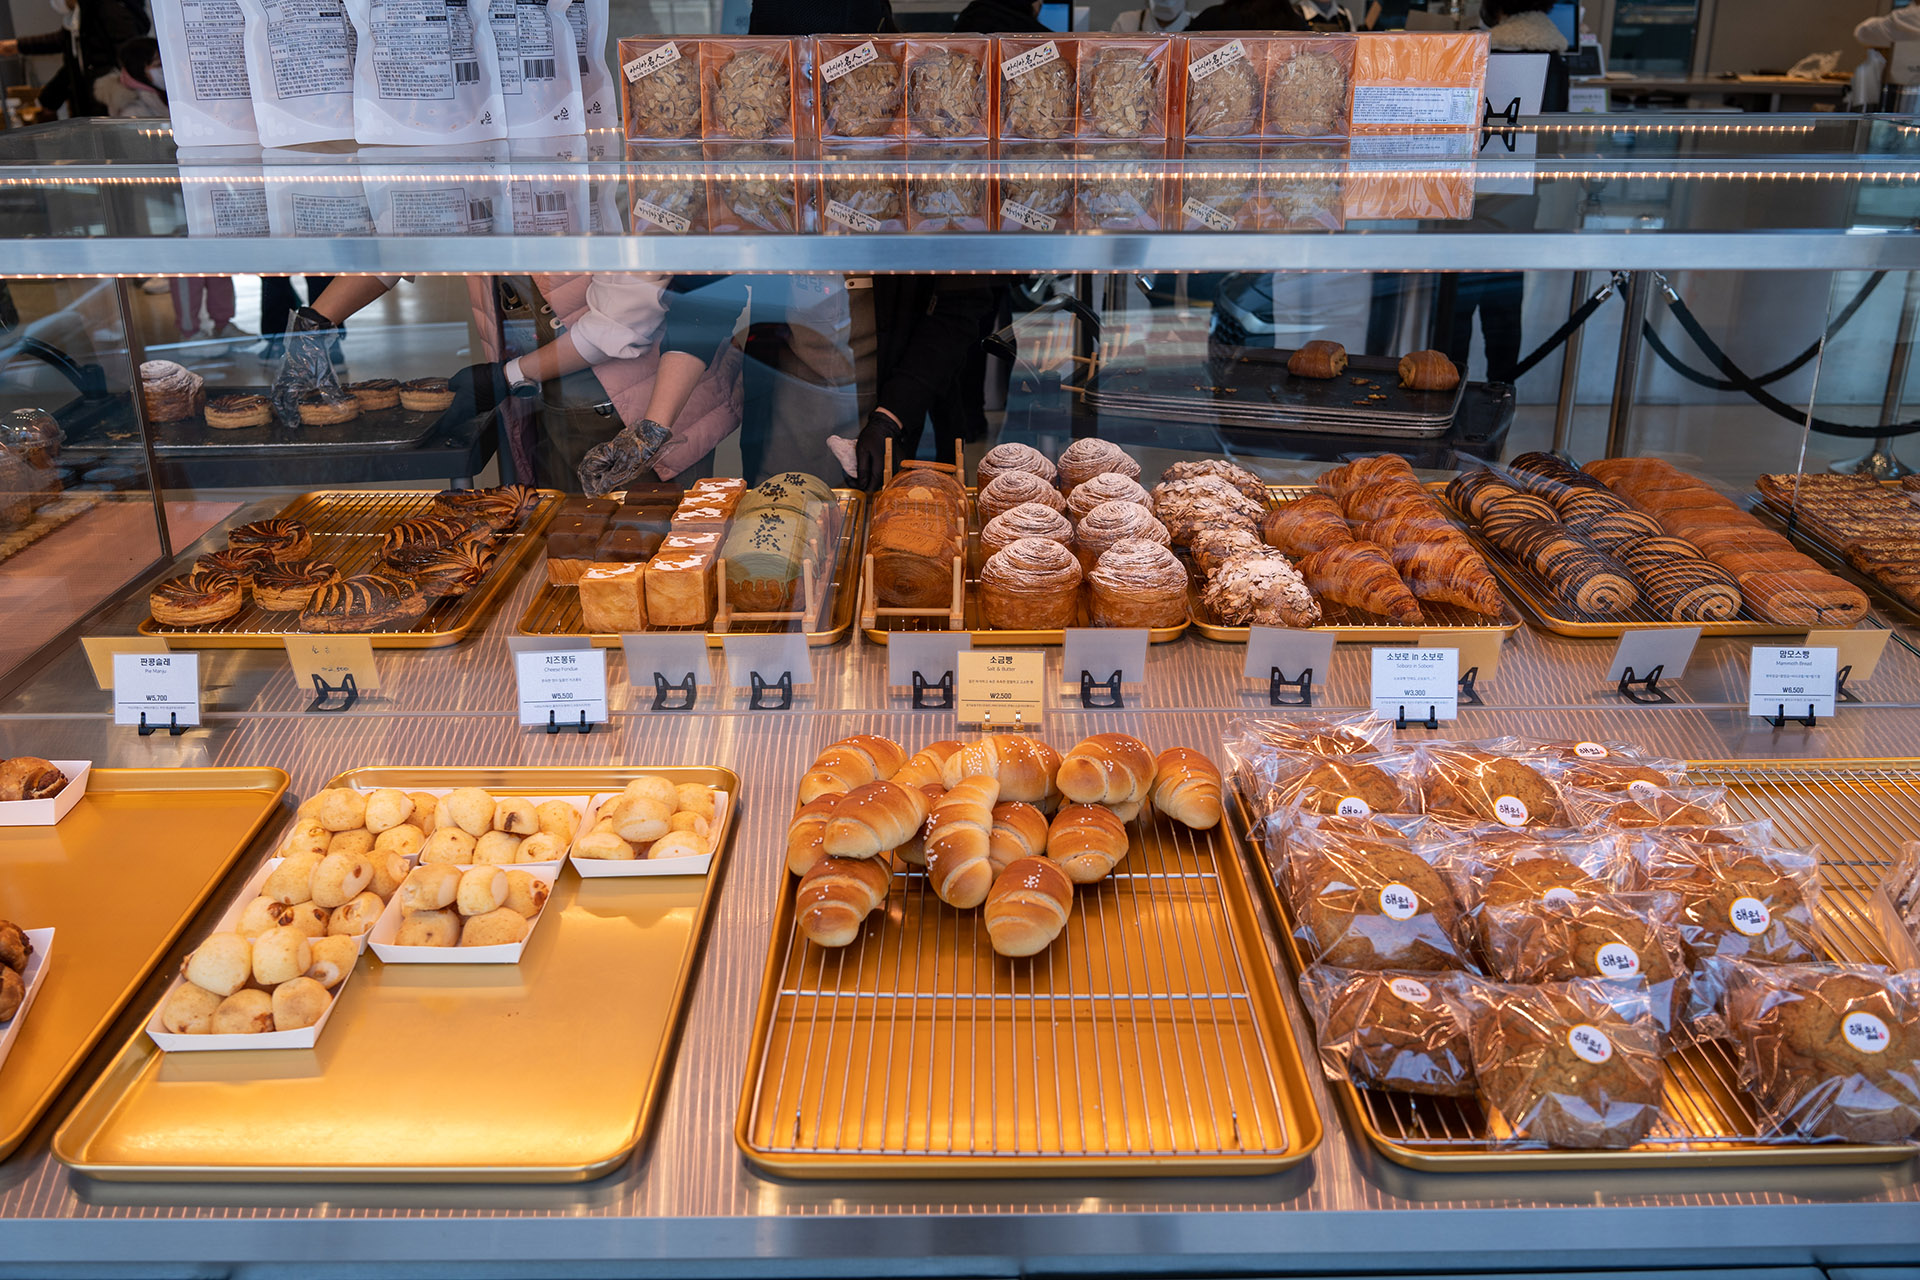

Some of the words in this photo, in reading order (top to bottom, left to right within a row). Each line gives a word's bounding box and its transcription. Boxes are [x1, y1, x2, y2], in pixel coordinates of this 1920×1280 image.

[545, 655, 576, 664] 치즈퐁듀
[990, 656, 1013, 664] 소금빵
[1386, 652, 1410, 661] 소보로
[1421, 652, 1444, 661] 소보로
